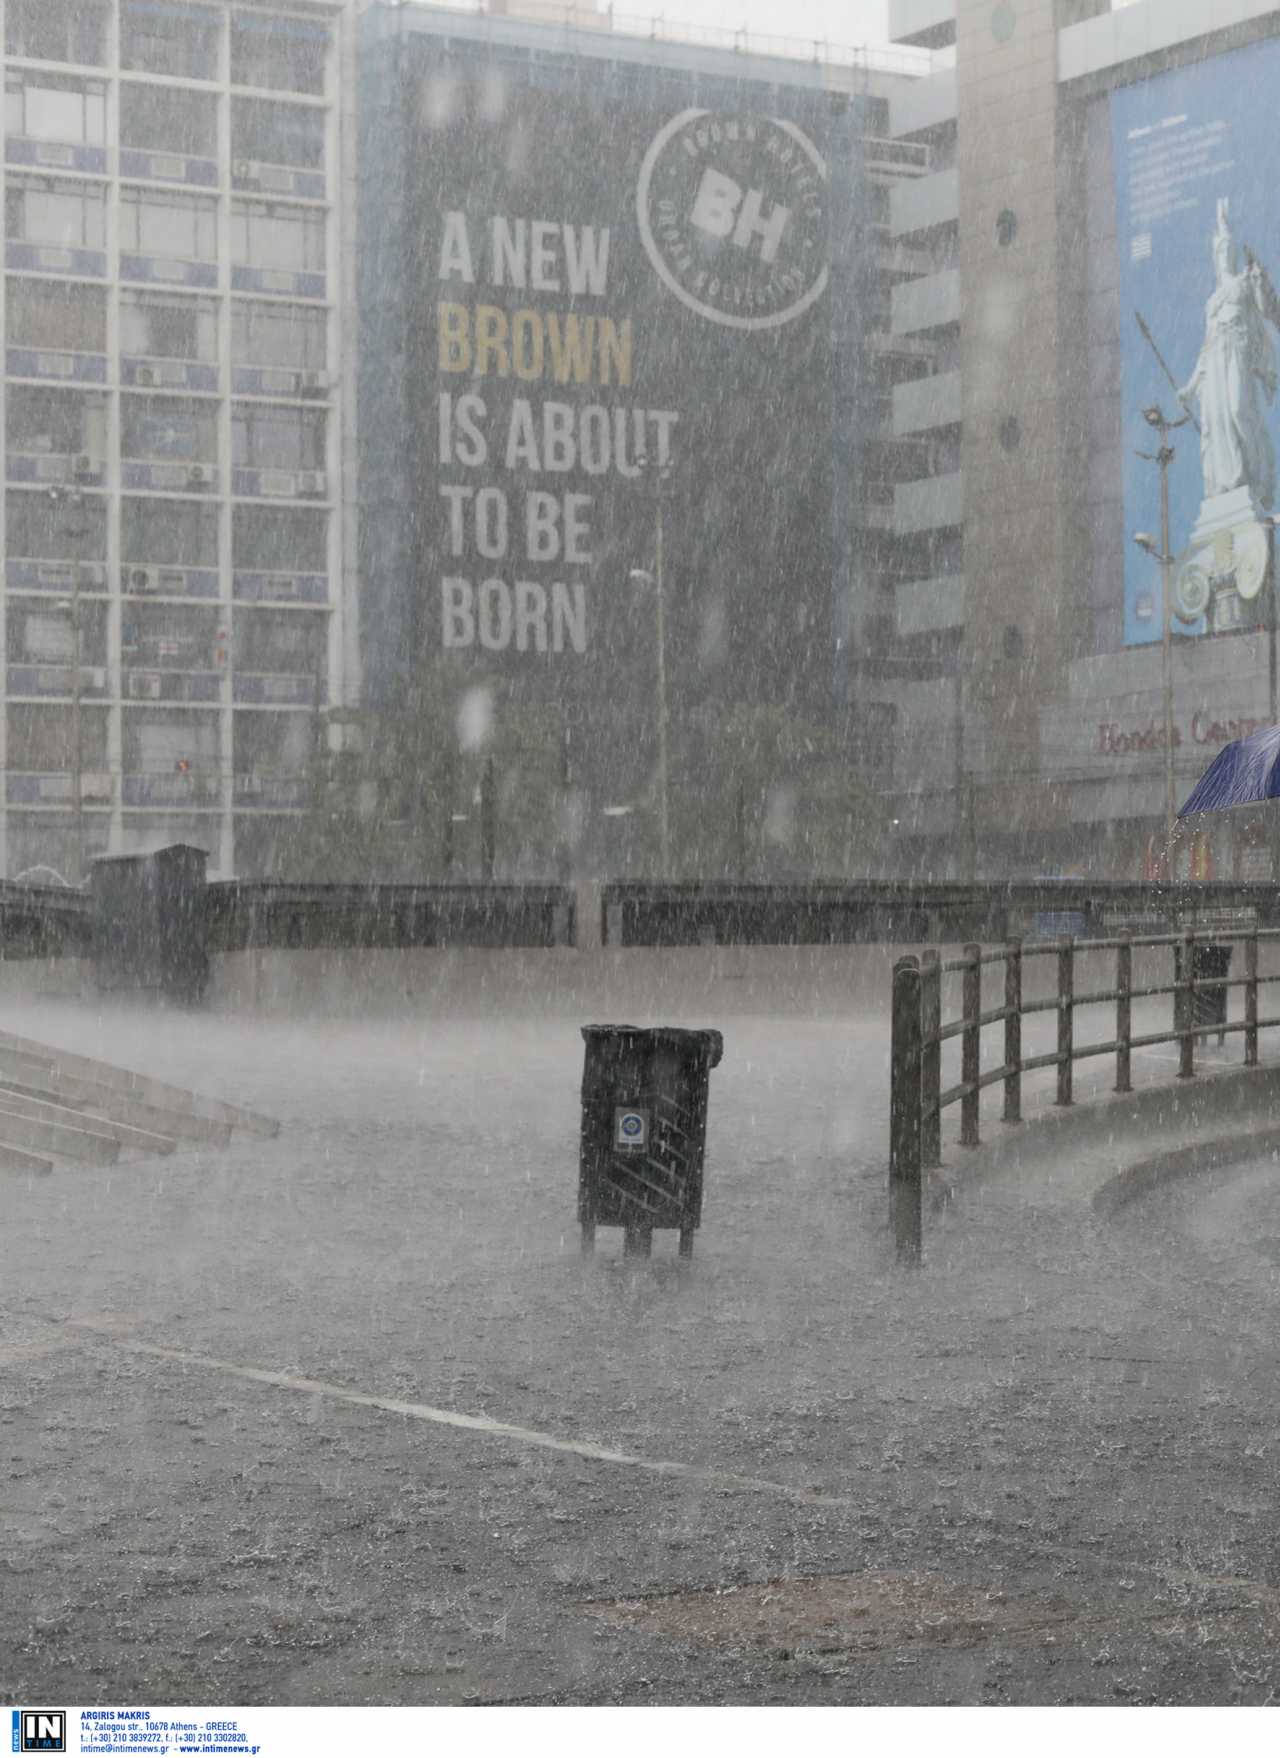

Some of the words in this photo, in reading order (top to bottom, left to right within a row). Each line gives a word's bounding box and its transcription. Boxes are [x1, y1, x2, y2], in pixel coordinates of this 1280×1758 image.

[438, 212, 474, 283] A
[491, 216, 610, 296] NEW
[690, 167, 792, 262] BH
[438, 302, 633, 385] BROWN
[438, 393, 486, 466] IS
[505, 398, 679, 479] ABOUT
[440, 485, 508, 561] TO
[526, 494, 594, 564] BE
[441, 578, 587, 653] BORN
